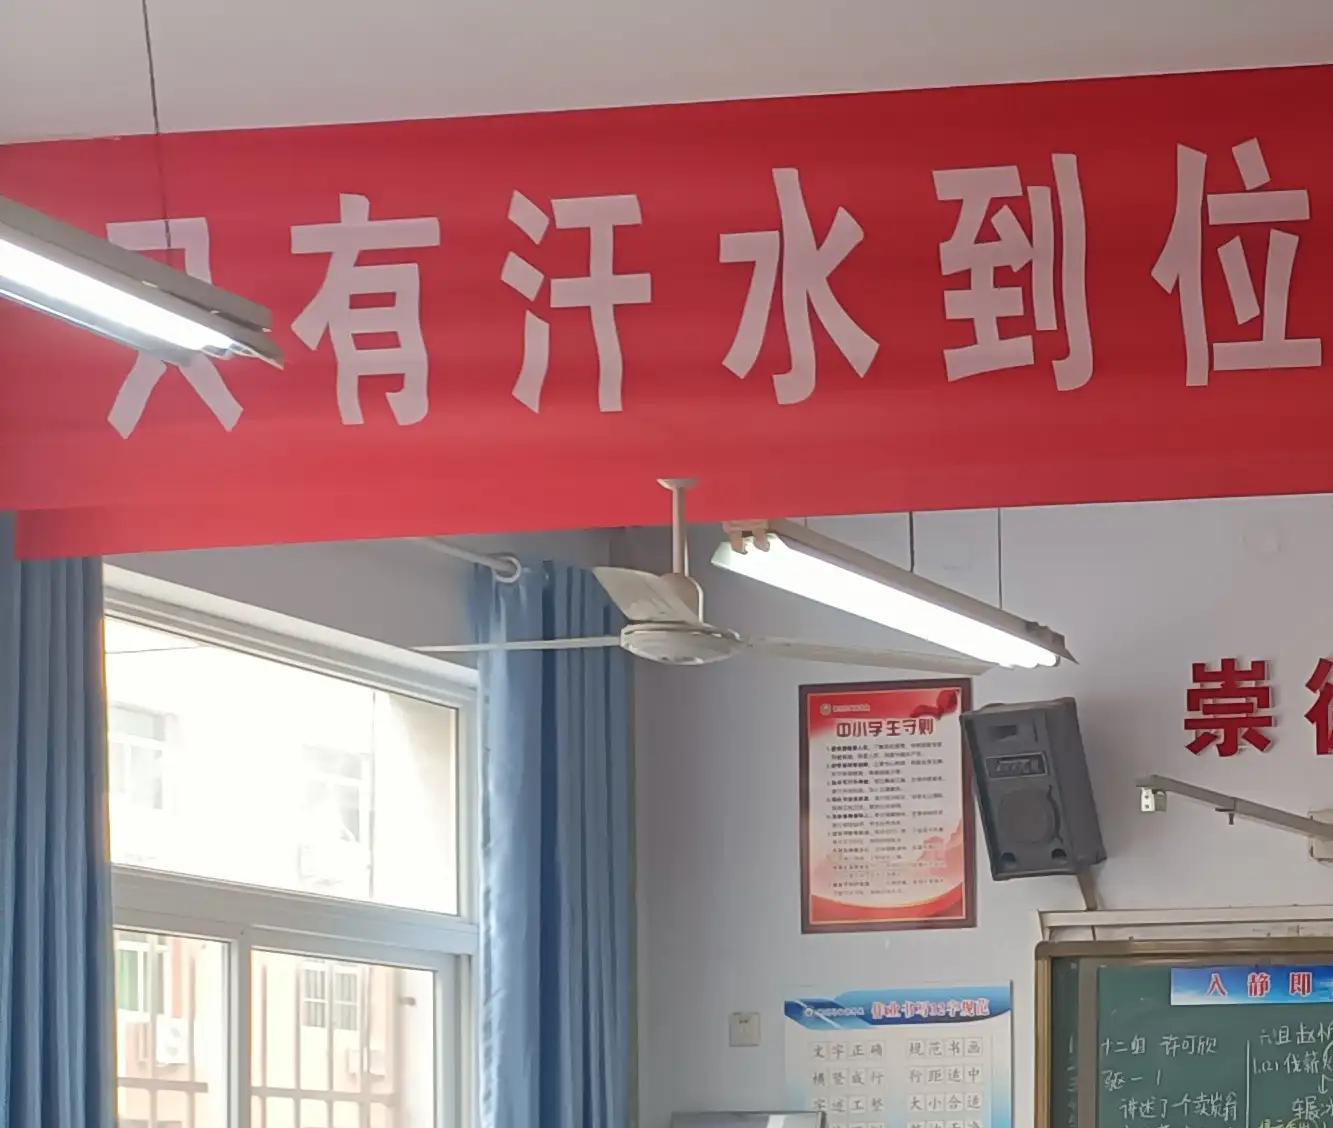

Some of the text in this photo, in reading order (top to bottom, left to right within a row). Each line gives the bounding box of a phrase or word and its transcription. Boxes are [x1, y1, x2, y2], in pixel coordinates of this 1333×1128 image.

[105, 138, 1325, 439] 只有汗水到位
[836, 718, 934, 738] 中小学生守则
